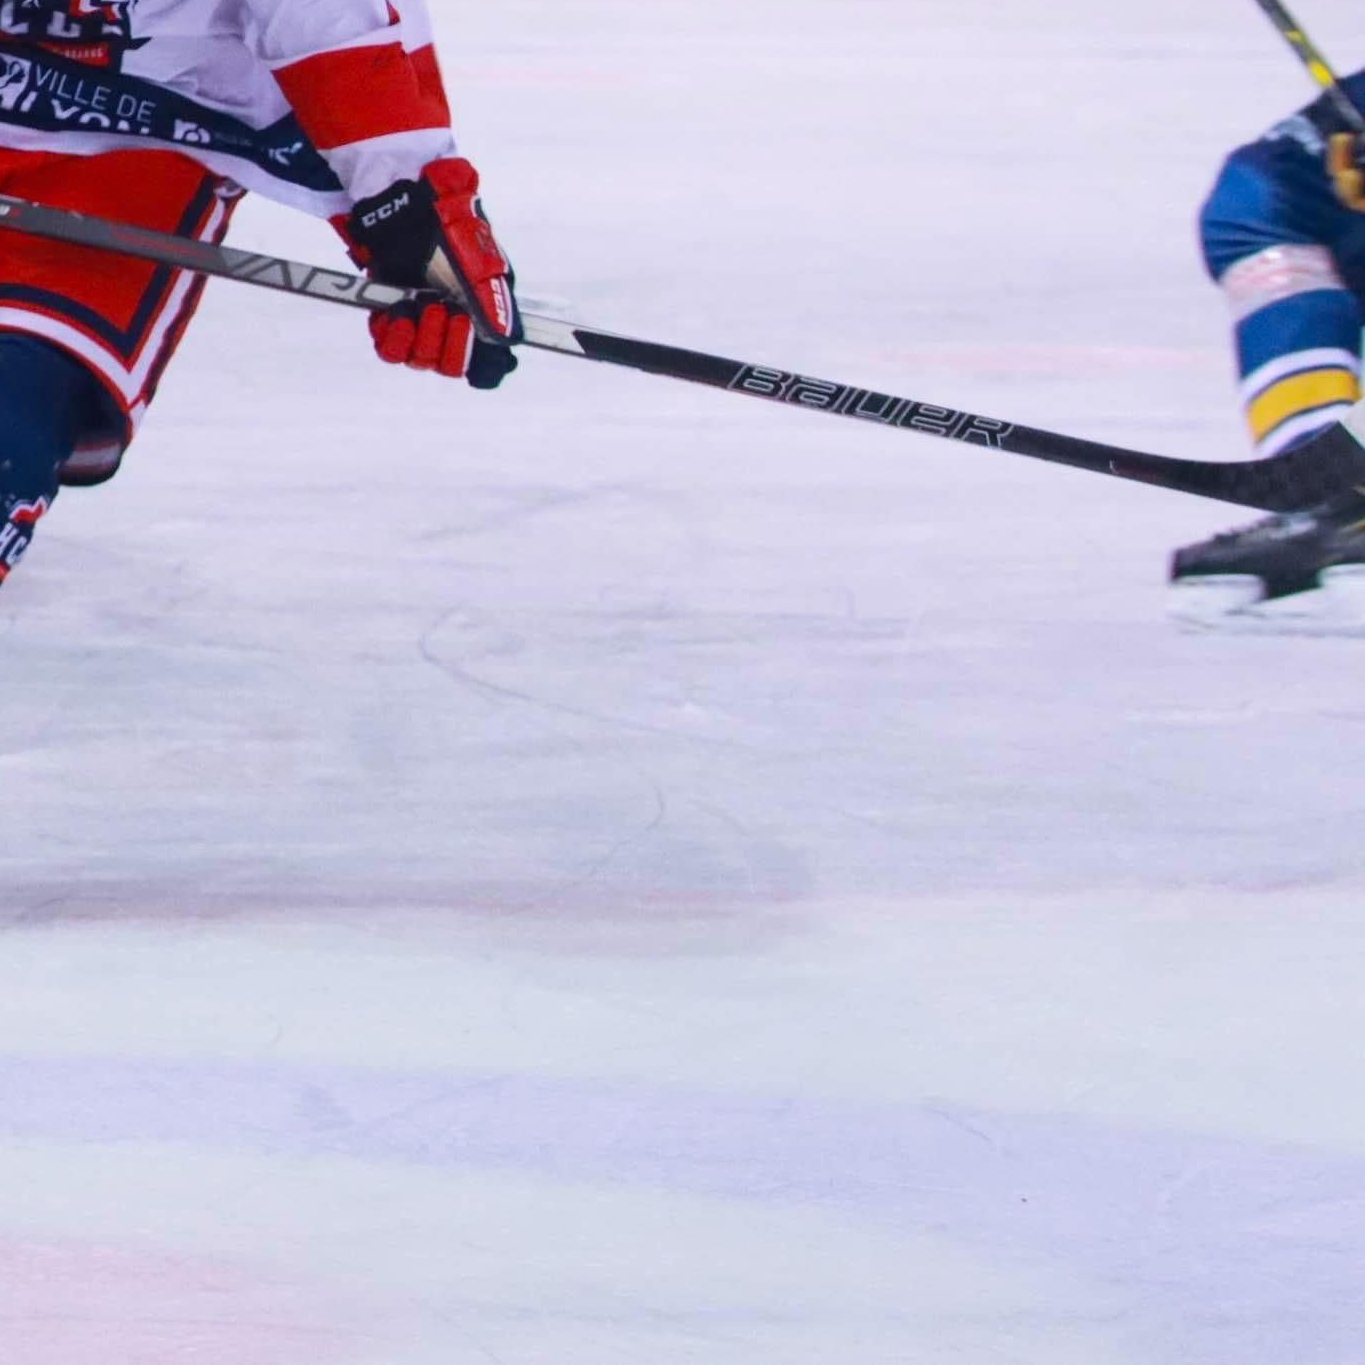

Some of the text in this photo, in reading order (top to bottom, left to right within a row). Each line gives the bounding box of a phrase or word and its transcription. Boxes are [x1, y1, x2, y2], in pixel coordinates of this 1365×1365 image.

[34, 62, 159, 124] VILLE DE
[361, 192, 411, 228] CCM
[221, 251, 419, 312] VAPO
[727, 362, 1015, 448] BAUER
